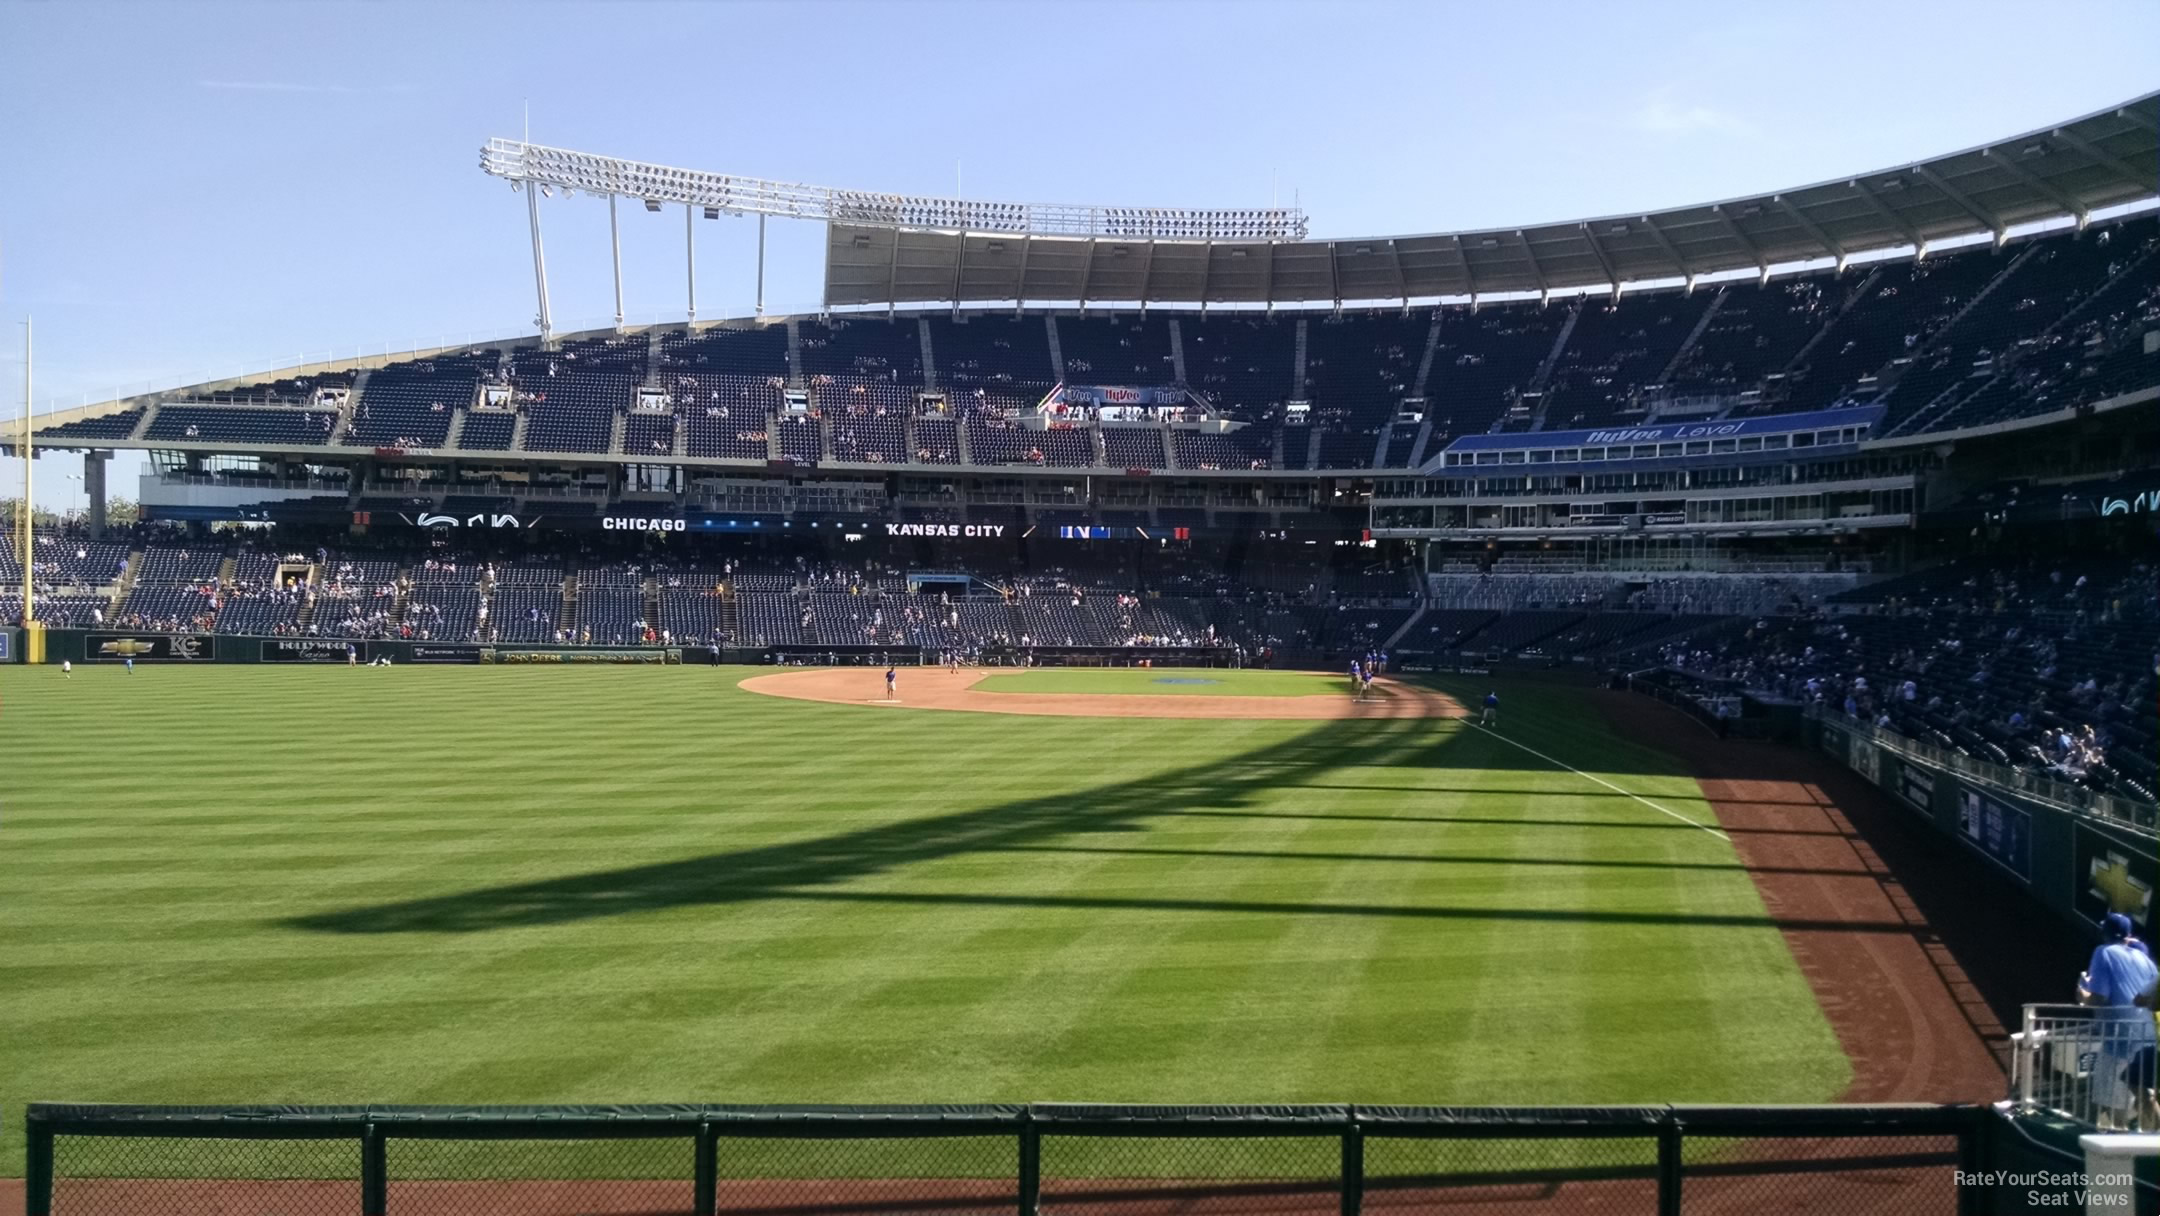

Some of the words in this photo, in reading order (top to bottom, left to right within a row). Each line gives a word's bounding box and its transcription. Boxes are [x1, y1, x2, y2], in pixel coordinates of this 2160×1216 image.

[1105, 388, 1140, 402] HyVee
[1586, 429, 1663, 443] HyVee
[1673, 421, 1746, 438] Level
[602, 517, 686, 532] CHICAGO
[886, 523, 960, 537] KANSAS
[964, 524, 1005, 538] CITY
[279, 641, 350, 650] HOLLYWOOD
[298, 649, 330, 659] Casino
[503, 653, 528, 662] JOHN
[531, 653, 562, 662] DEERE
